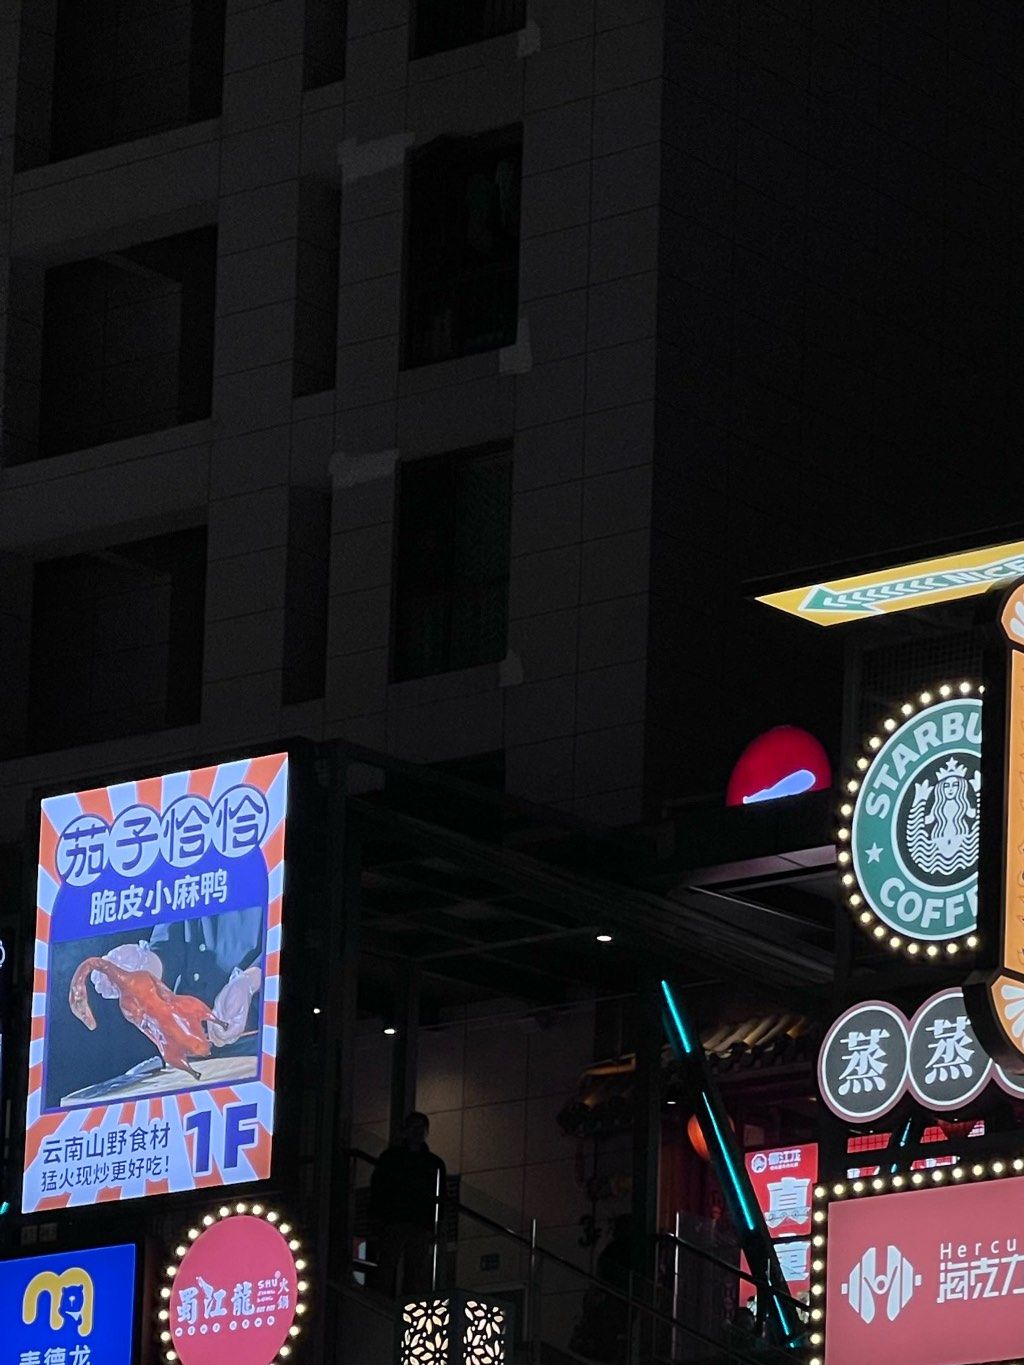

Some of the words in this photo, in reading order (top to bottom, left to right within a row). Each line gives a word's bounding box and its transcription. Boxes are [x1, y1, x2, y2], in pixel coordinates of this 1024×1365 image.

[63, 795, 266, 878] 茄子恰恰
[89, 868, 228, 926] 脆皮小麻鸭
[42, 1122, 171, 1164] 云南山野食材
[184, 1102, 260, 1173] 1F
[177, 1276, 255, 1324] 蜀江龍
